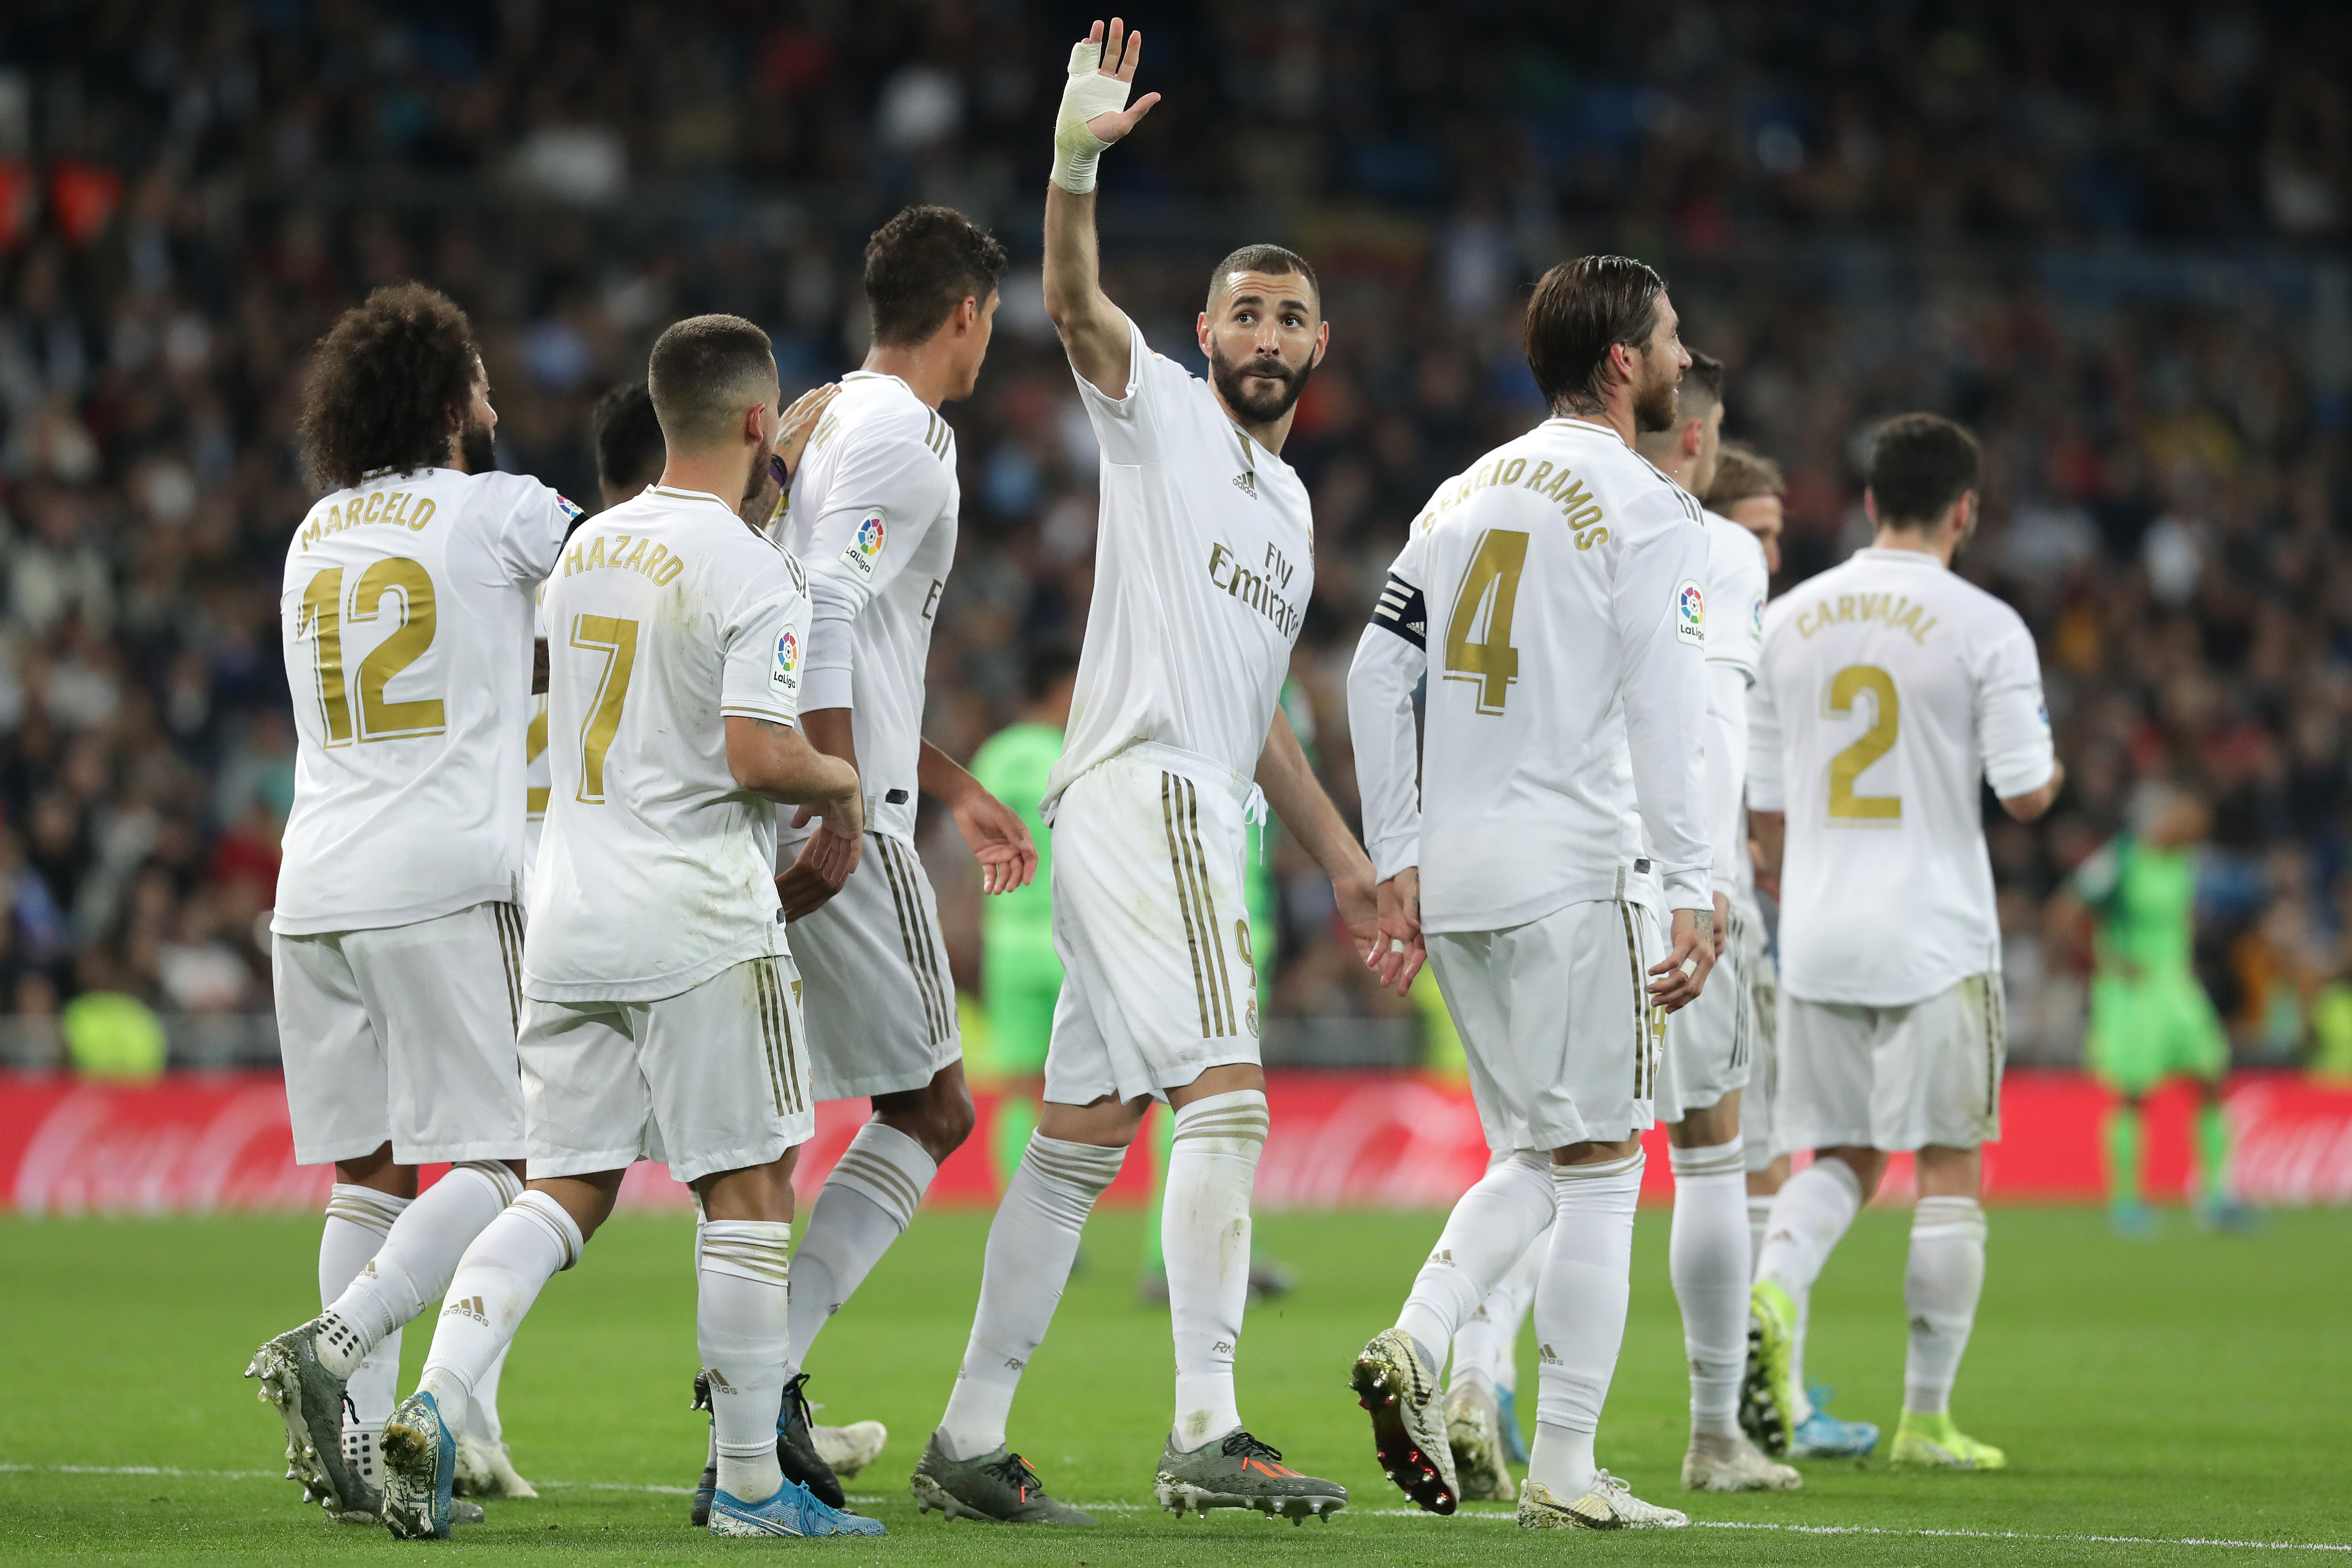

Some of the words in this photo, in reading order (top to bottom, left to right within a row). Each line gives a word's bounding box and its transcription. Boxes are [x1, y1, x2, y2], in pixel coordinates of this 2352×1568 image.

[1232, 477, 1257, 500] adidas
[1422, 458, 1527, 536] SERGIO
[1524, 461, 1609, 551] RAMOS
[301, 492, 436, 552] MARCELO
[564, 536, 684, 587] HAZARD
[845, 546, 871, 574] LaLiga
[1265, 541, 1293, 590] Fly
[1442, 528, 1529, 717] 4
[1797, 592, 1937, 645] CARVAJAL
[297, 557, 445, 749] 12
[774, 671, 796, 689] LaLiga
[570, 613, 639, 804] 7
[1820, 665, 1902, 830] 2
[443, 1305, 490, 1327] adidas
